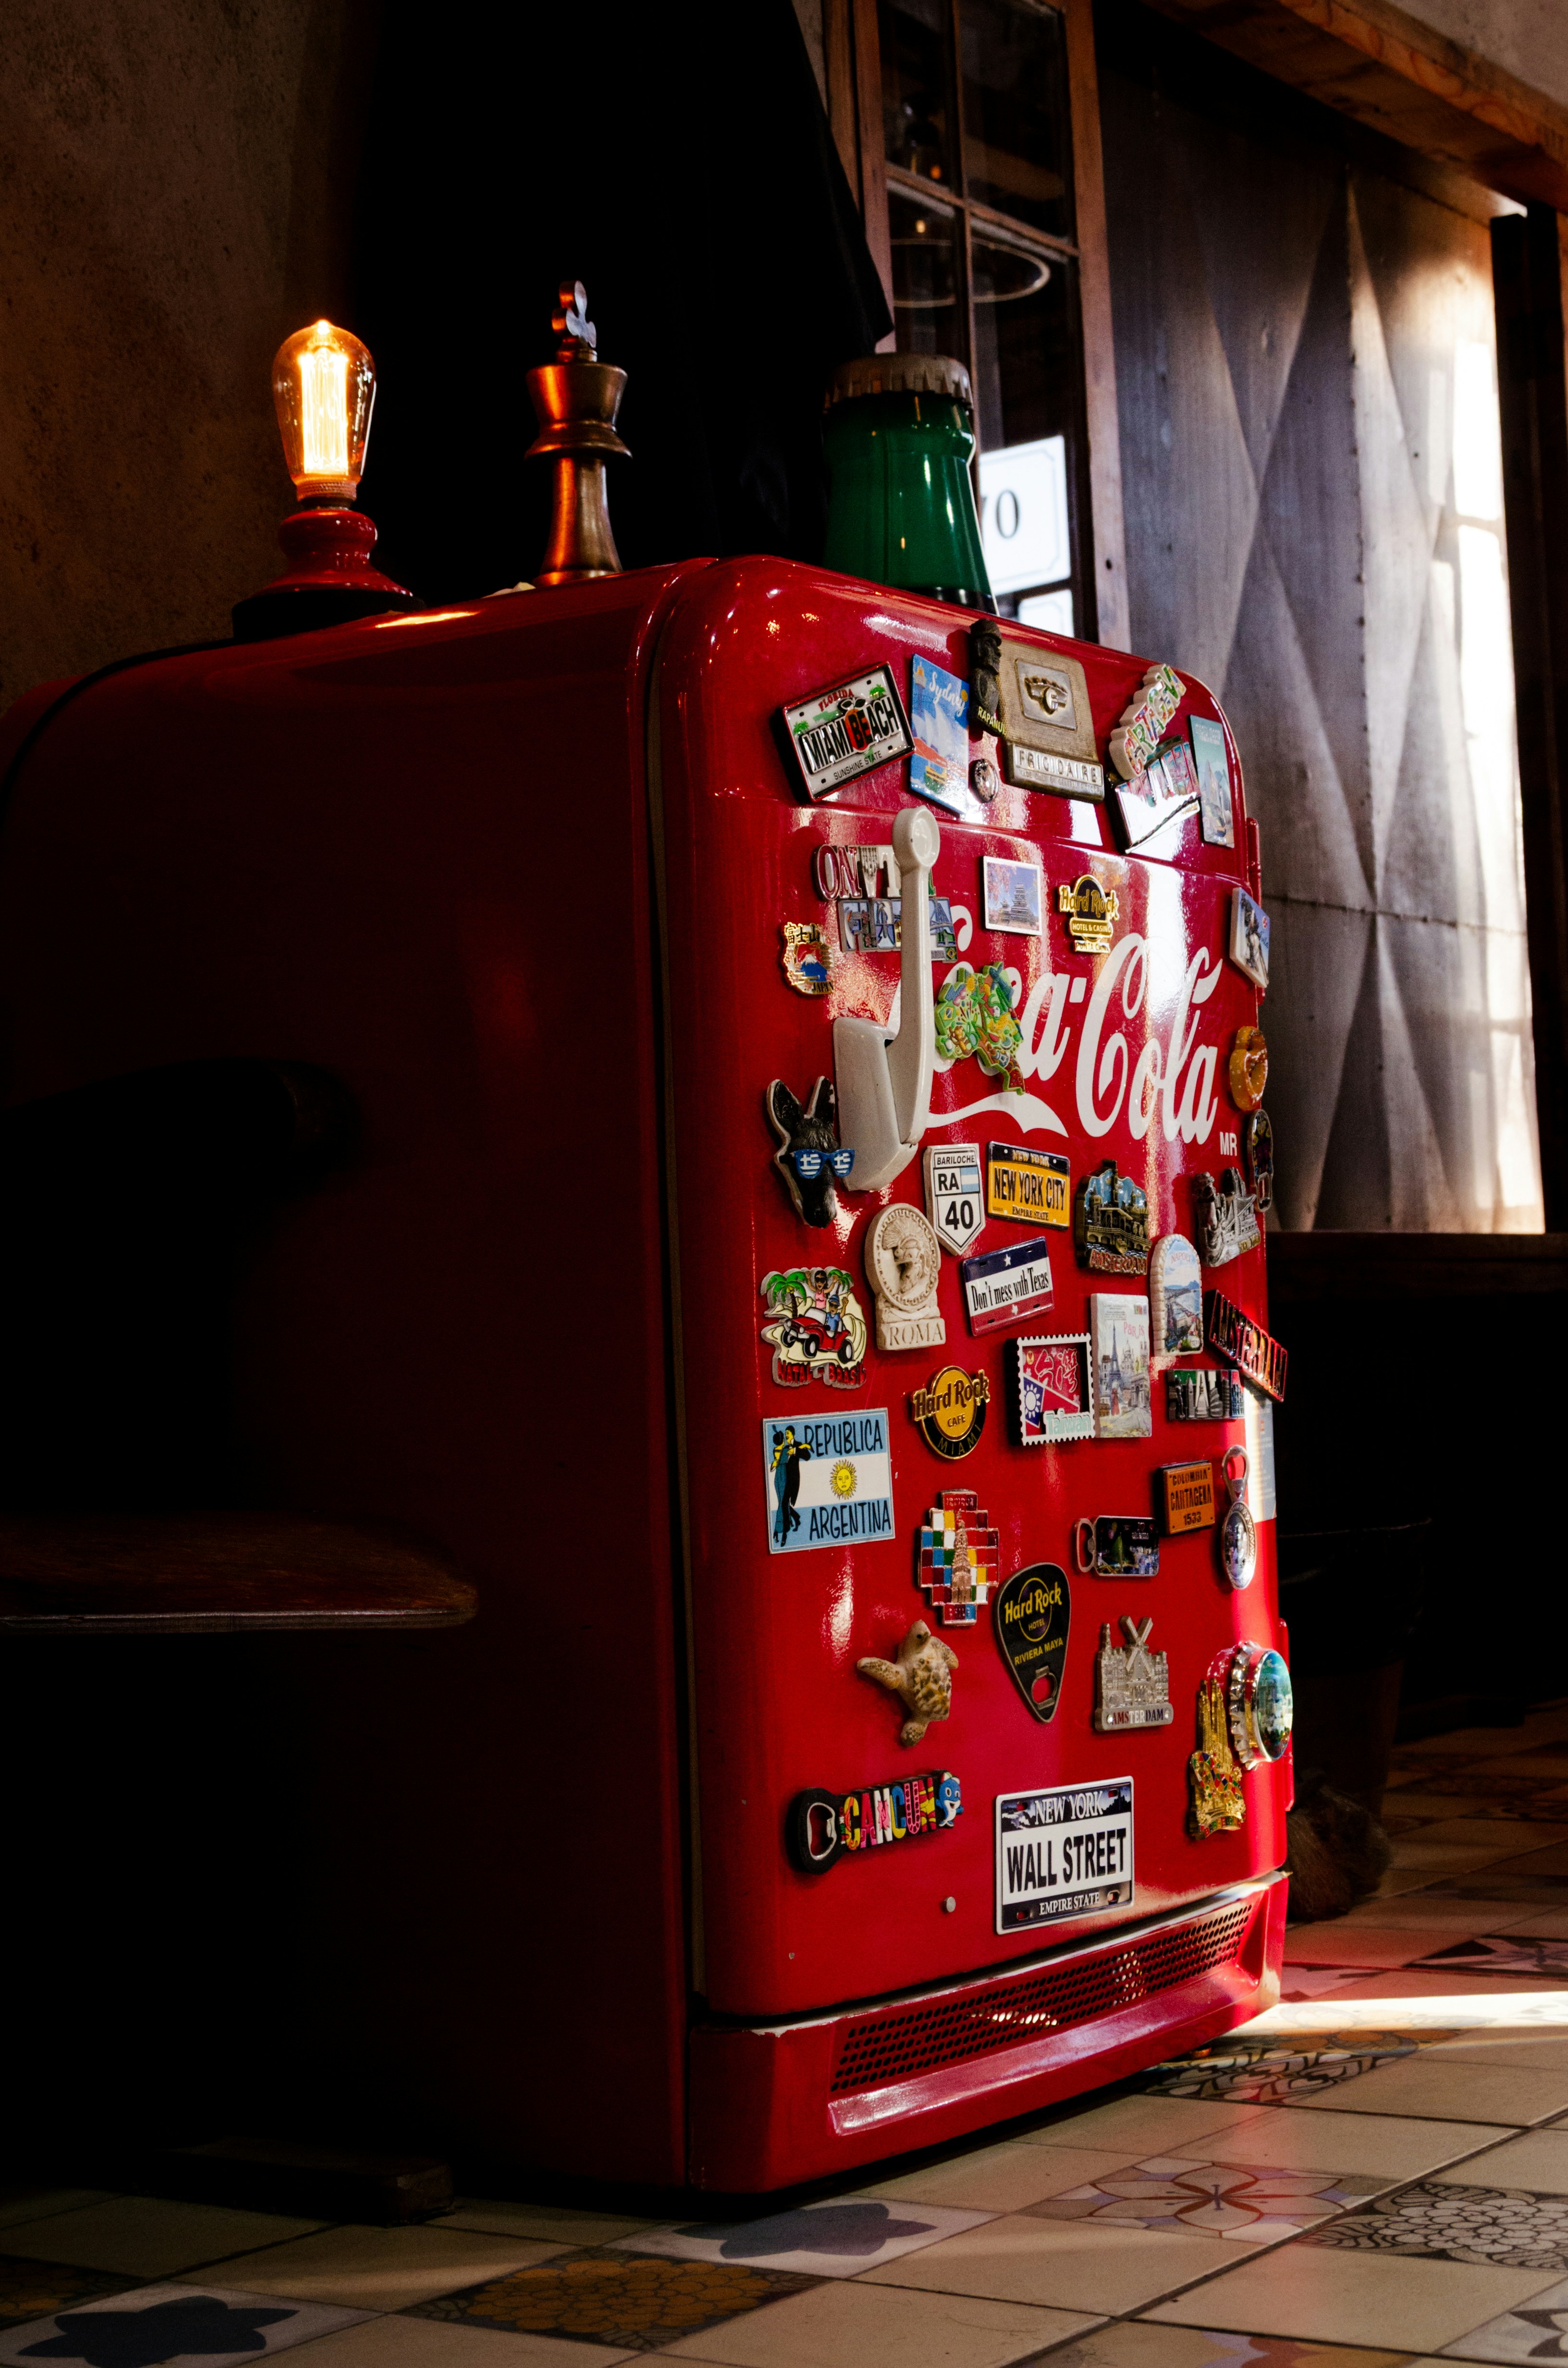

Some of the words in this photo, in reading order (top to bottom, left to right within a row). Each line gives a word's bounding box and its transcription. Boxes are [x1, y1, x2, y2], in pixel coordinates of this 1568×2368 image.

[818, 689, 854, 712] FLORIDA
[929, 671, 966, 717] Sydney
[802, 718, 854, 771] MIAMI
[848, 697, 899, 749] BEACH
[833, 761, 863, 780] SUNSHINE
[865, 751, 882, 765] STATE
[1019, 750, 1097, 783] FRIGIDAIRE
[1060, 886, 1089, 912] Hard
[1091, 889, 1119, 920] Rock
[784, 923, 821, 944] 富士山
[1072, 923, 1088, 931] HOTEL
[1076, 942, 1093, 951] PUNTA
[812, 982, 834, 993] JAPAN
[1012, 1149, 1029, 1162] NEW
[1030, 1152, 1050, 1167] YORK
[1220, 1132, 1237, 1157] MR
[937, 1155, 975, 1165] BARILOCHE
[938, 1172, 959, 1191] RA
[994, 1167, 1017, 1202] NEW
[1018, 1170, 1043, 1207] YORK
[1045, 1176, 1066, 1210] CITY
[945, 1200, 974, 1230] 40
[1012, 1205, 1033, 1217] EMPIRE
[1034, 1210, 1049, 1221] STATE
[1090, 1248, 1148, 1275] AMSTERDAM
[1171, 1251, 1191, 1264] NAPOLI
[971, 1281, 993, 1311] Don't
[993, 1284, 1013, 1305] mess
[1013, 1269, 1029, 1297] with
[1028, 1267, 1049, 1293] Texas
[890, 1322, 943, 1346] ROMA
[777, 1357, 813, 1384] NATAL
[914, 1383, 952, 1419] Hard
[954, 1369, 990, 1408] Rock
[947, 1414, 966, 1428] CAFE
[1046, 1410, 1091, 1435] Taiwan
[804, 1419, 883, 1457] REPUBLICA
[938, 1424, 981, 1455] MIAMI
[1173, 1469, 1208, 1486] COLOMBIA
[1171, 1484, 1212, 1511] CARTAGENA
[809, 1500, 891, 1541] ARGENTINA
[1184, 1511, 1201, 1525] 1533
[1004, 1592, 1033, 1624] Hard
[1034, 1581, 1062, 1614] Rock
[1028, 1618, 1045, 1631] HOTEL
[1014, 1645, 1043, 1666] RIVIERA
[1044, 1637, 1064, 1653] MAYA
[1112, 1708, 1164, 1725] AMSTERDAM
[844, 1777, 937, 1850] CANCUN
[1034, 1796, 1066, 1825] NEW
[1068, 1790, 1104, 1820] YORK
[1007, 1840, 1057, 1894] WALL
[1063, 1827, 1127, 1884] STREET
[1039, 1898, 1073, 1916] EMPIRE
[1073, 1891, 1100, 1909] STATE
